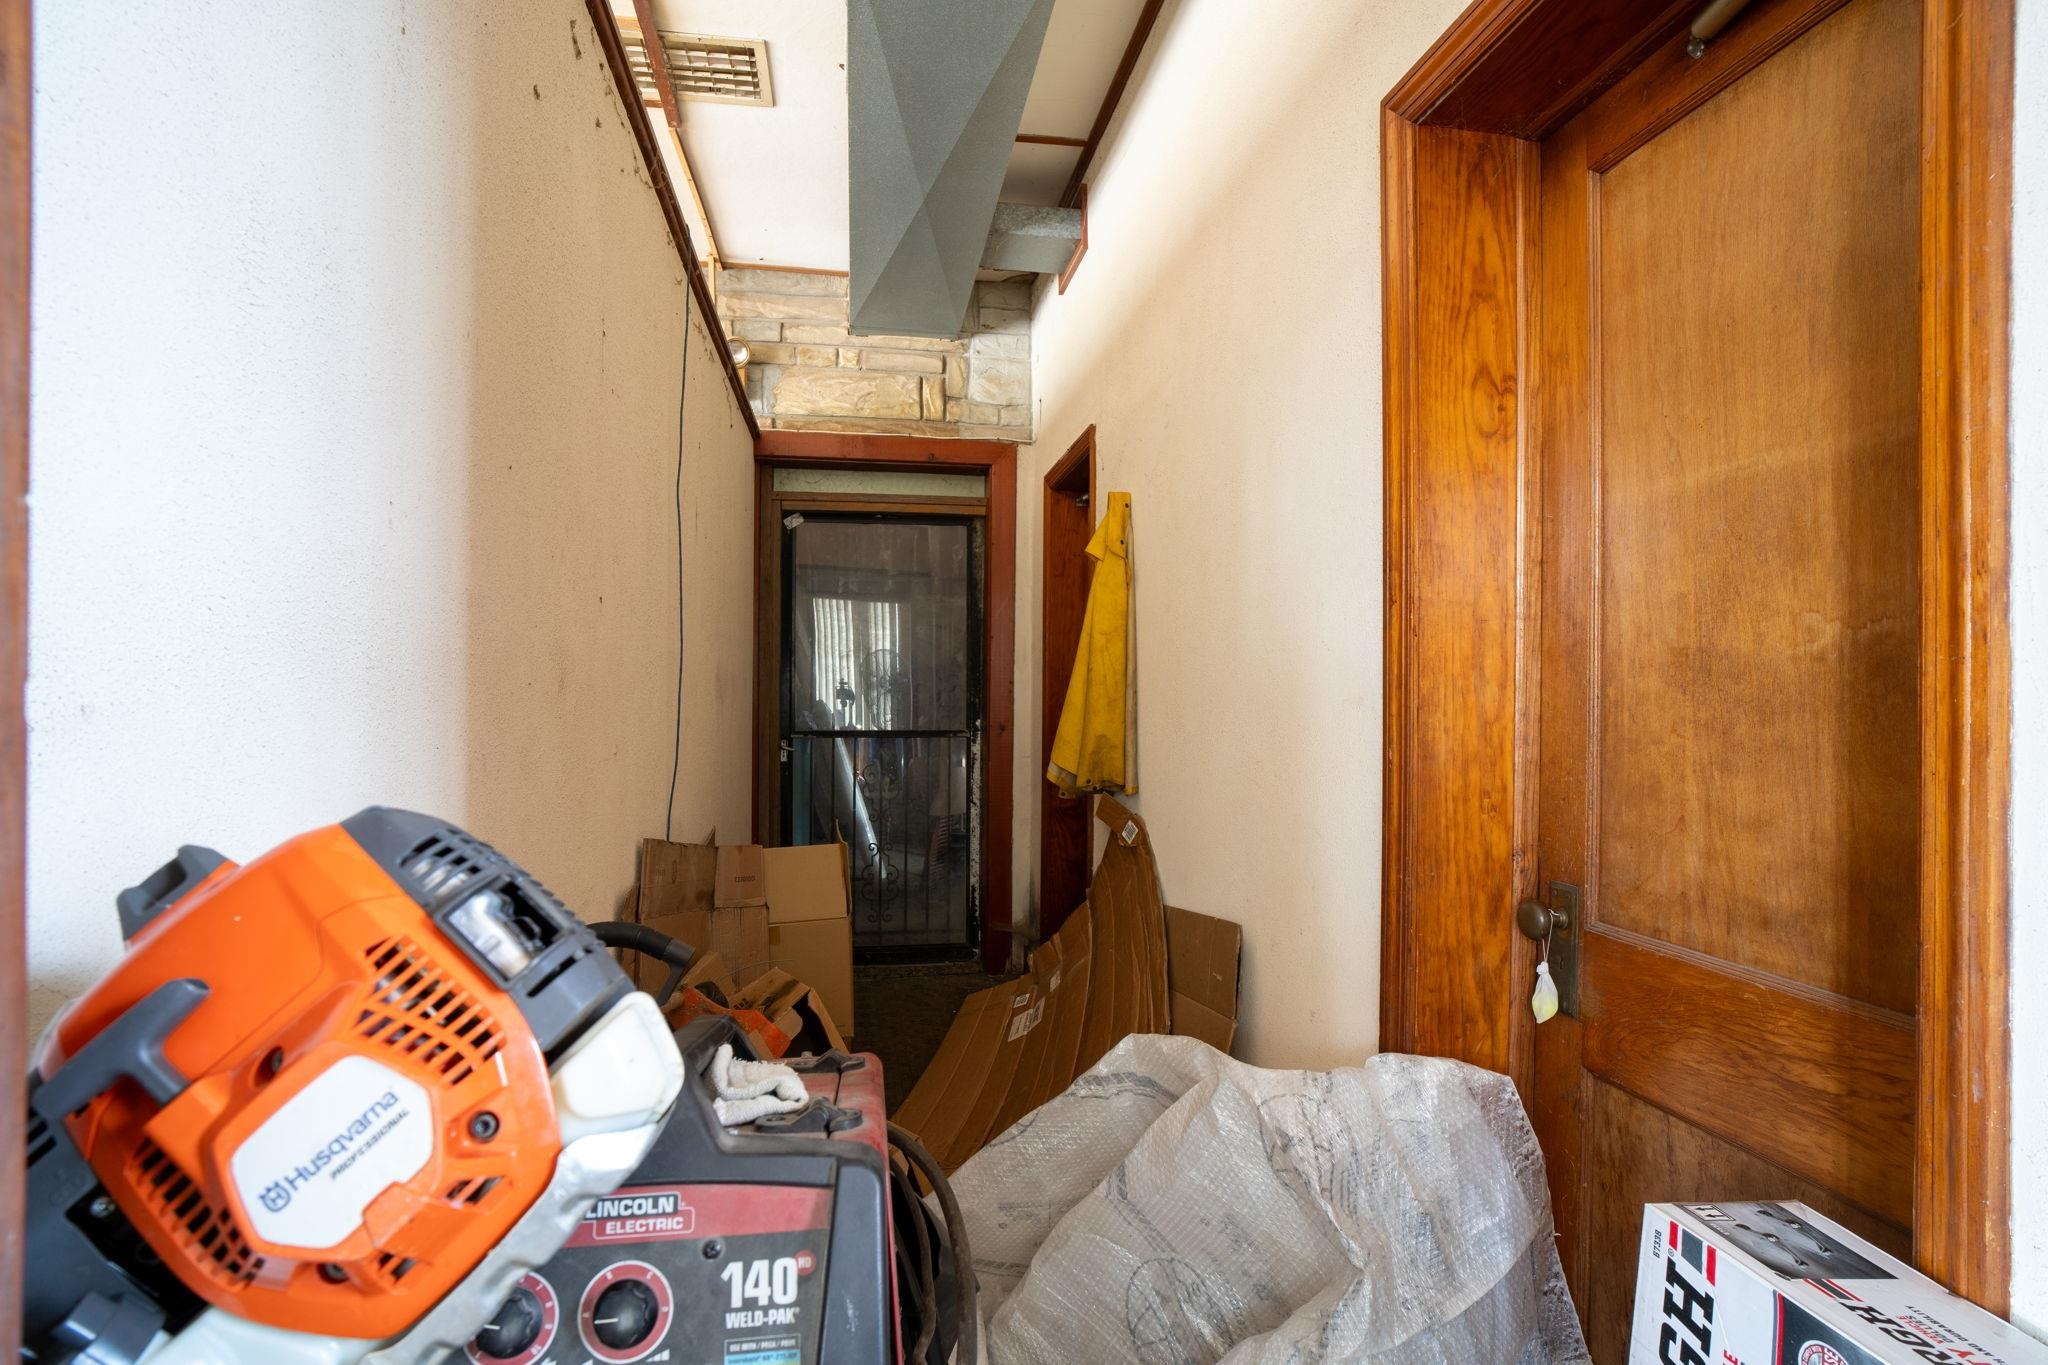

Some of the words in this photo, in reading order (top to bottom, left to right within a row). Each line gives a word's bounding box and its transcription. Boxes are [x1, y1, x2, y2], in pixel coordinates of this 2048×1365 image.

[284, 1091, 398, 1191] Husqvarna
[330, 1107, 410, 1180] PROFESSIONAL
[605, 1216, 684, 1235] ELECTRIC
[1653, 1229, 1662, 1259] 67338
[720, 1256, 799, 1309] 140
[725, 1308, 797, 1330] WELD-PAK
